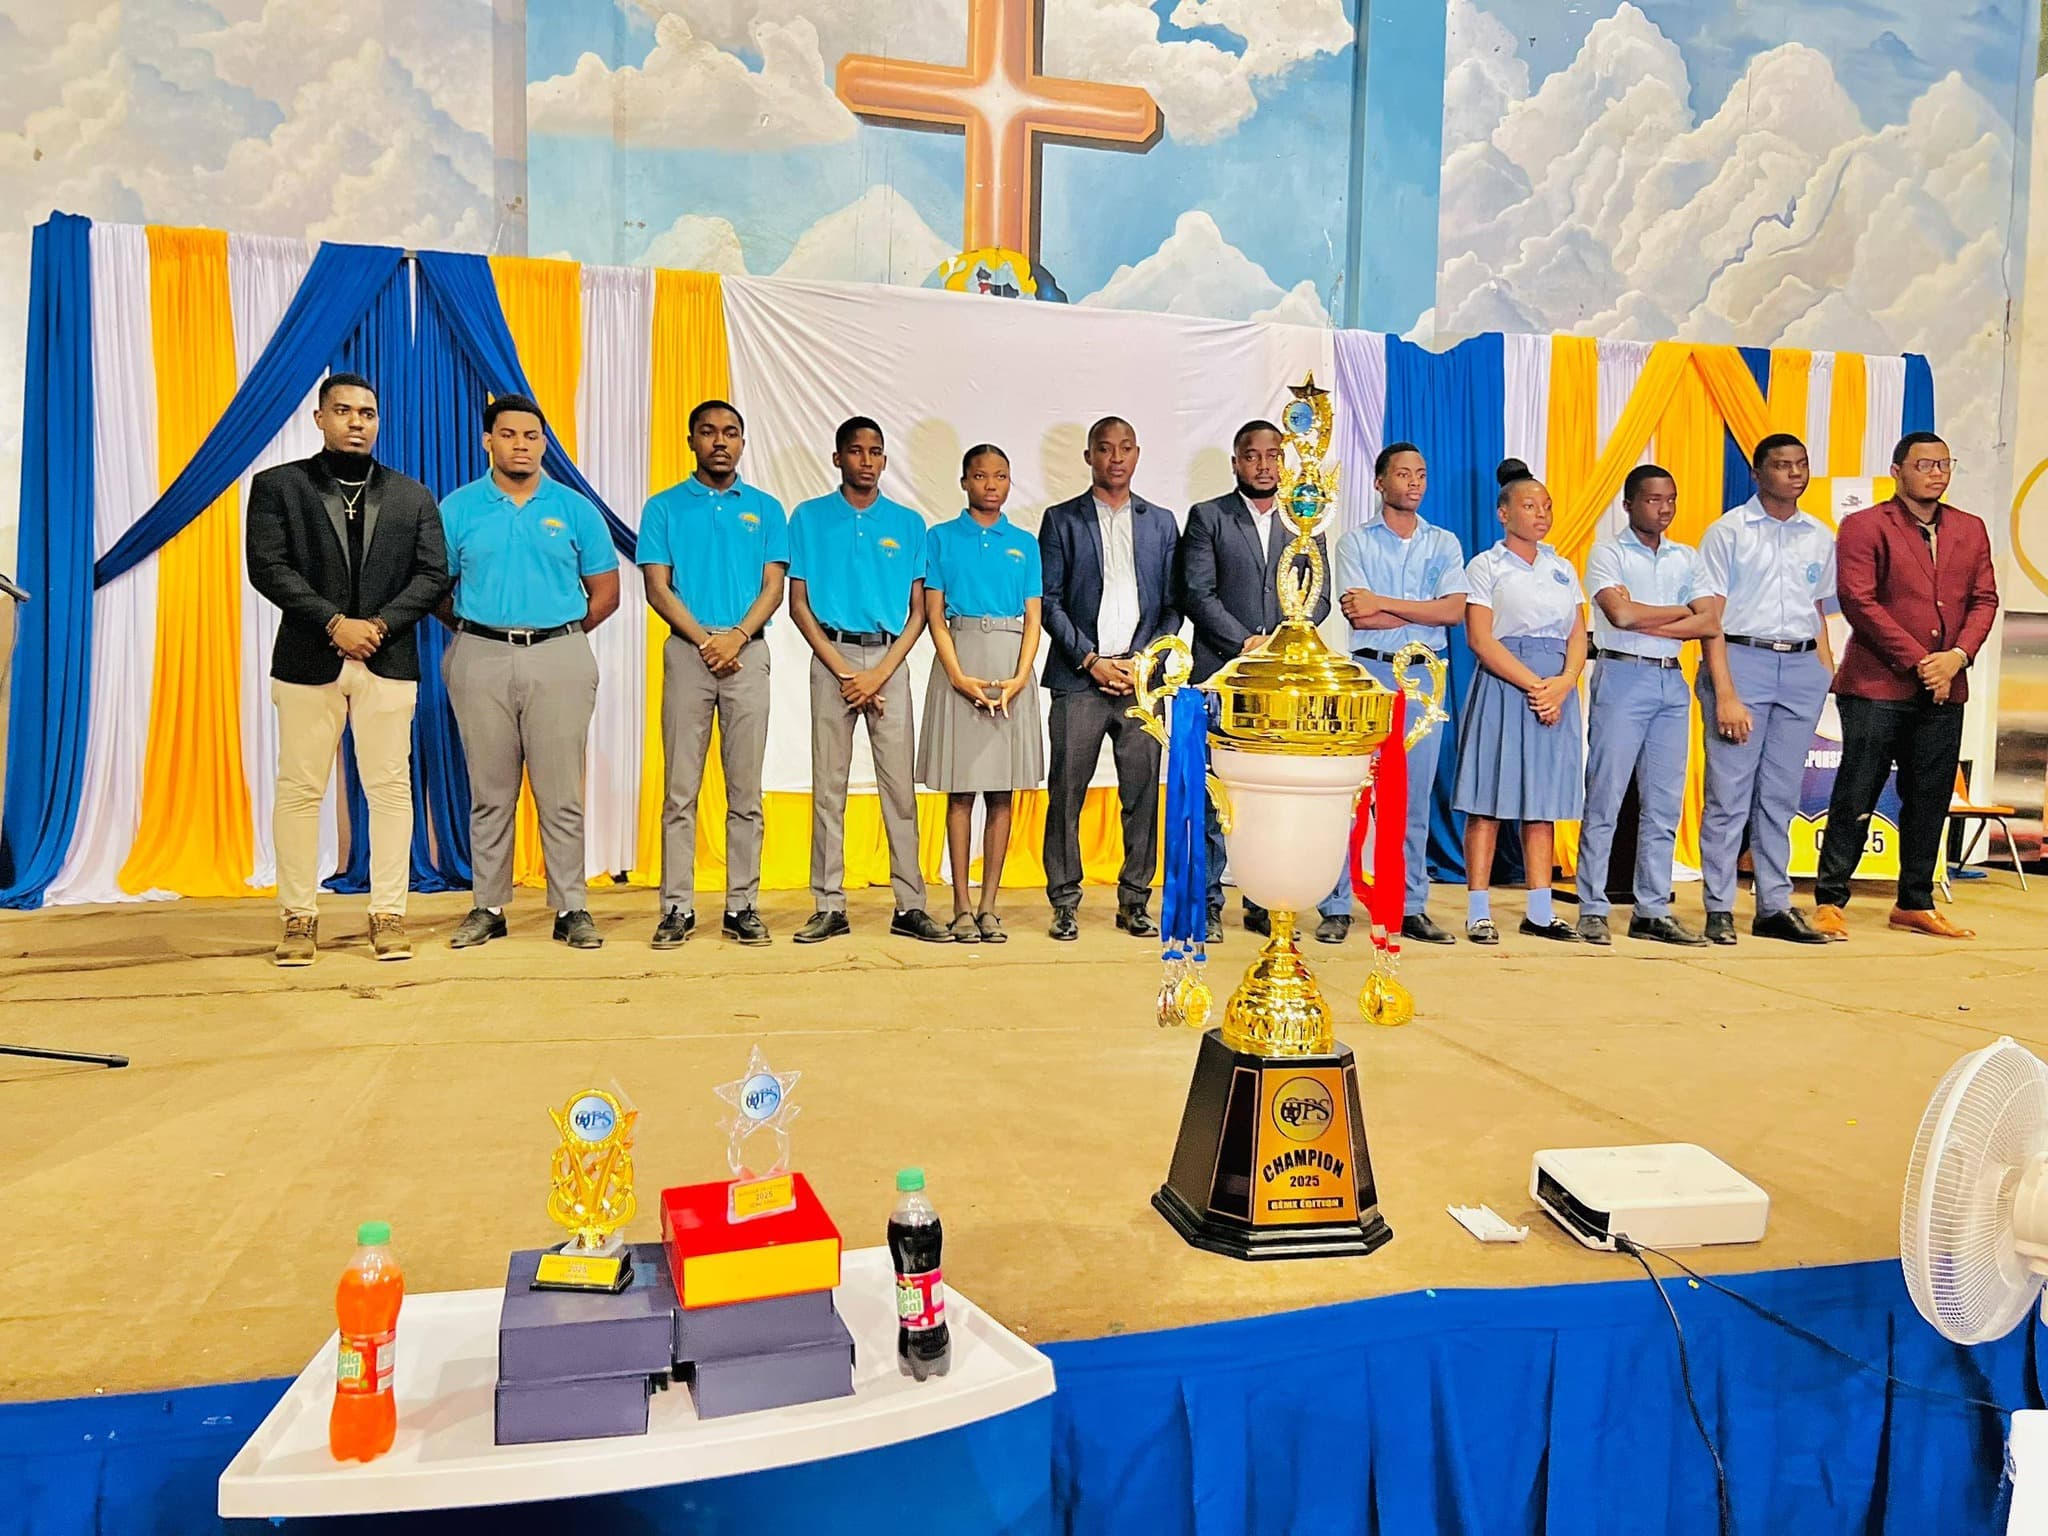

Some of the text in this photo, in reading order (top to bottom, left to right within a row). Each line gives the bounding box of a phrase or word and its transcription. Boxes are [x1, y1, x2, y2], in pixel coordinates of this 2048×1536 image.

[1804, 750, 1842, 768] PONS
[1263, 1149, 1345, 1183] CHAMPION
[1290, 1175, 1320, 1187] 2025
